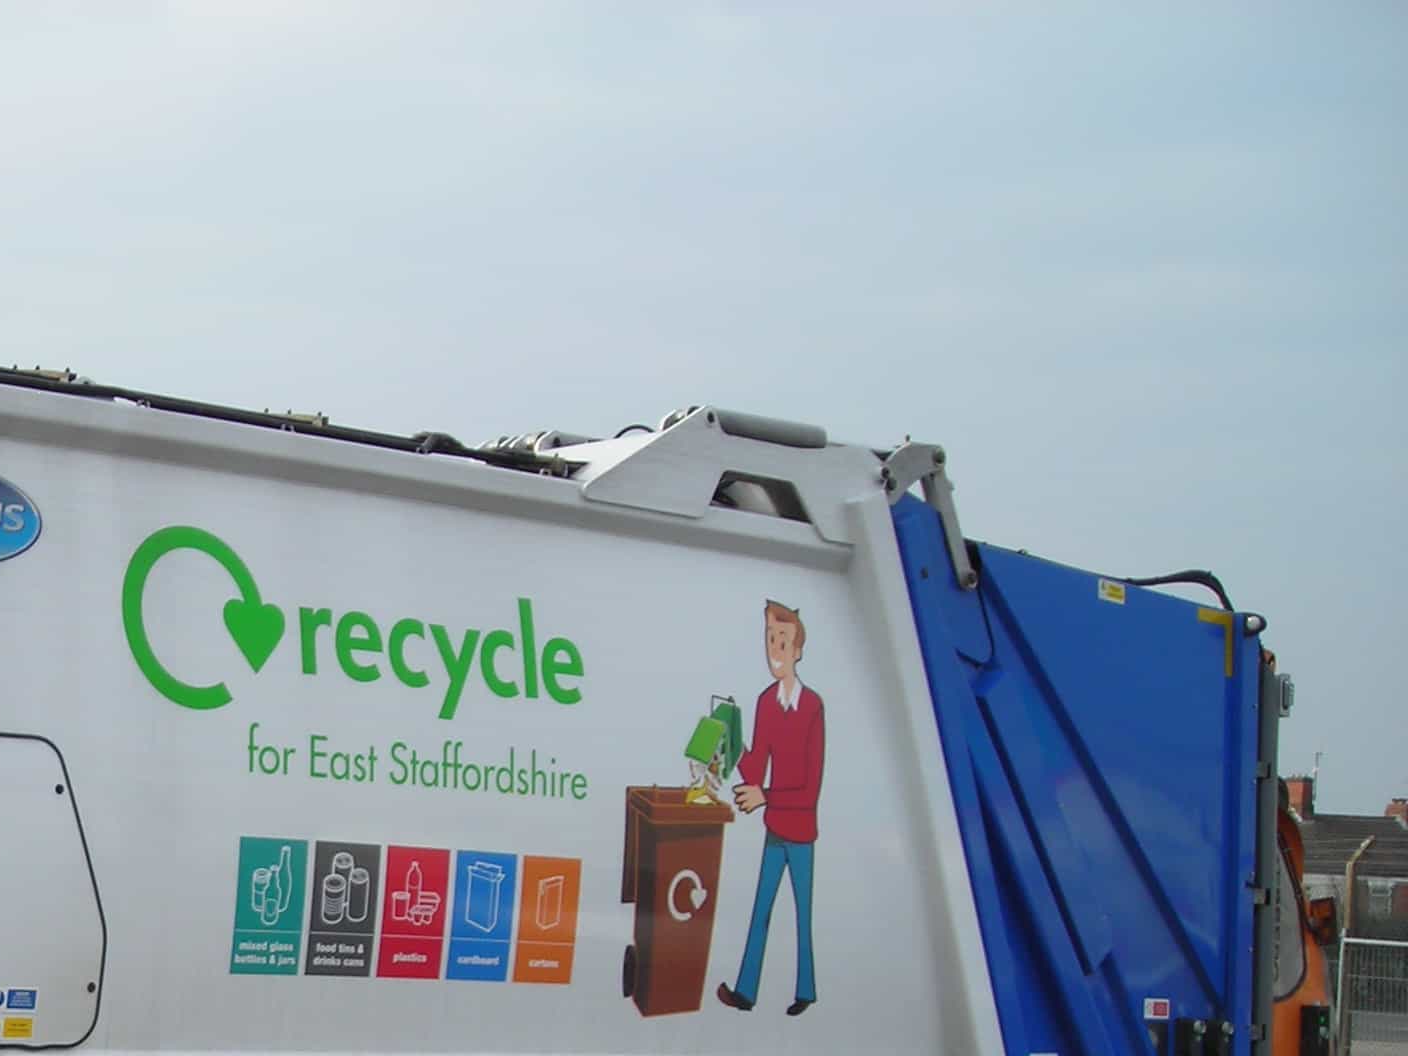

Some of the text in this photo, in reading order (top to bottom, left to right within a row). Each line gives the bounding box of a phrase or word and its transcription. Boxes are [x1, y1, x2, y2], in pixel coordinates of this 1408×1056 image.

[299, 598, 585, 720] recycle
[248, 722, 588, 800] for East Staffordshire
[239, 940, 294, 952] mixed glass
[316, 942, 337, 953] food
[338, 943, 355, 954] tins
[234, 953, 267, 964] bottles
[277, 956, 296, 966] jars
[313, 956, 341, 966] drinks
[392, 952, 428, 964] plastics
